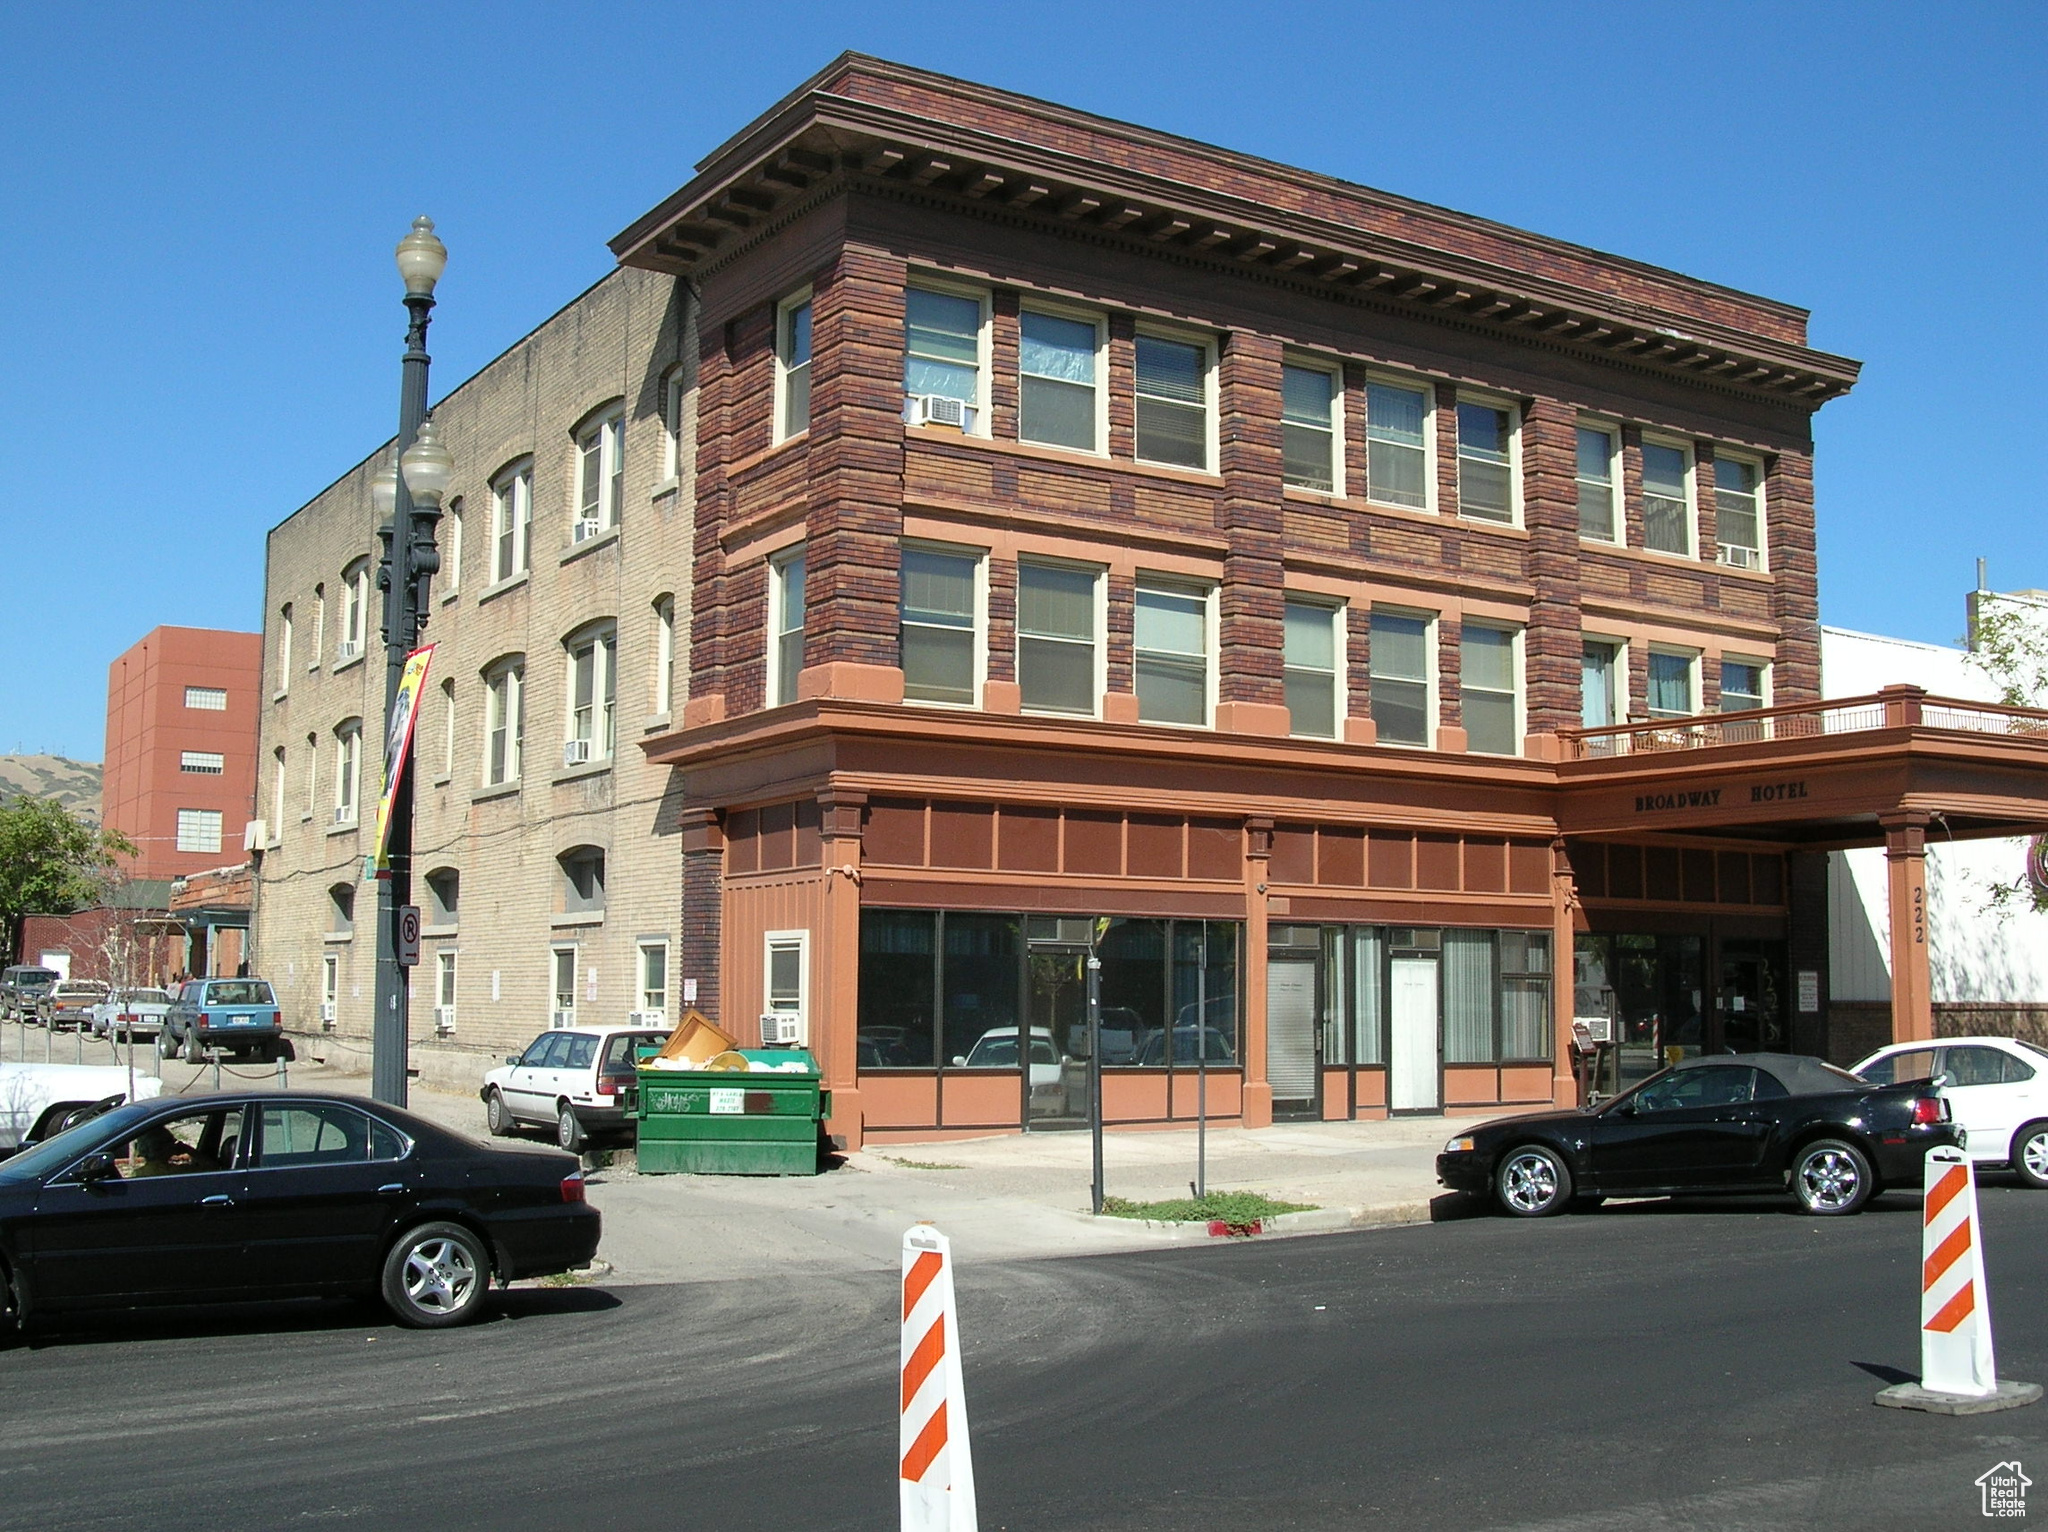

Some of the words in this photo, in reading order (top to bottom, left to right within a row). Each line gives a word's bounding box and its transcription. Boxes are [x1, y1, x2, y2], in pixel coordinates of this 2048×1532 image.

[1635, 789, 1721, 812] BROADWAY
[1751, 781, 1808, 803] HOTEL
[1914, 886, 1924, 944] 222
